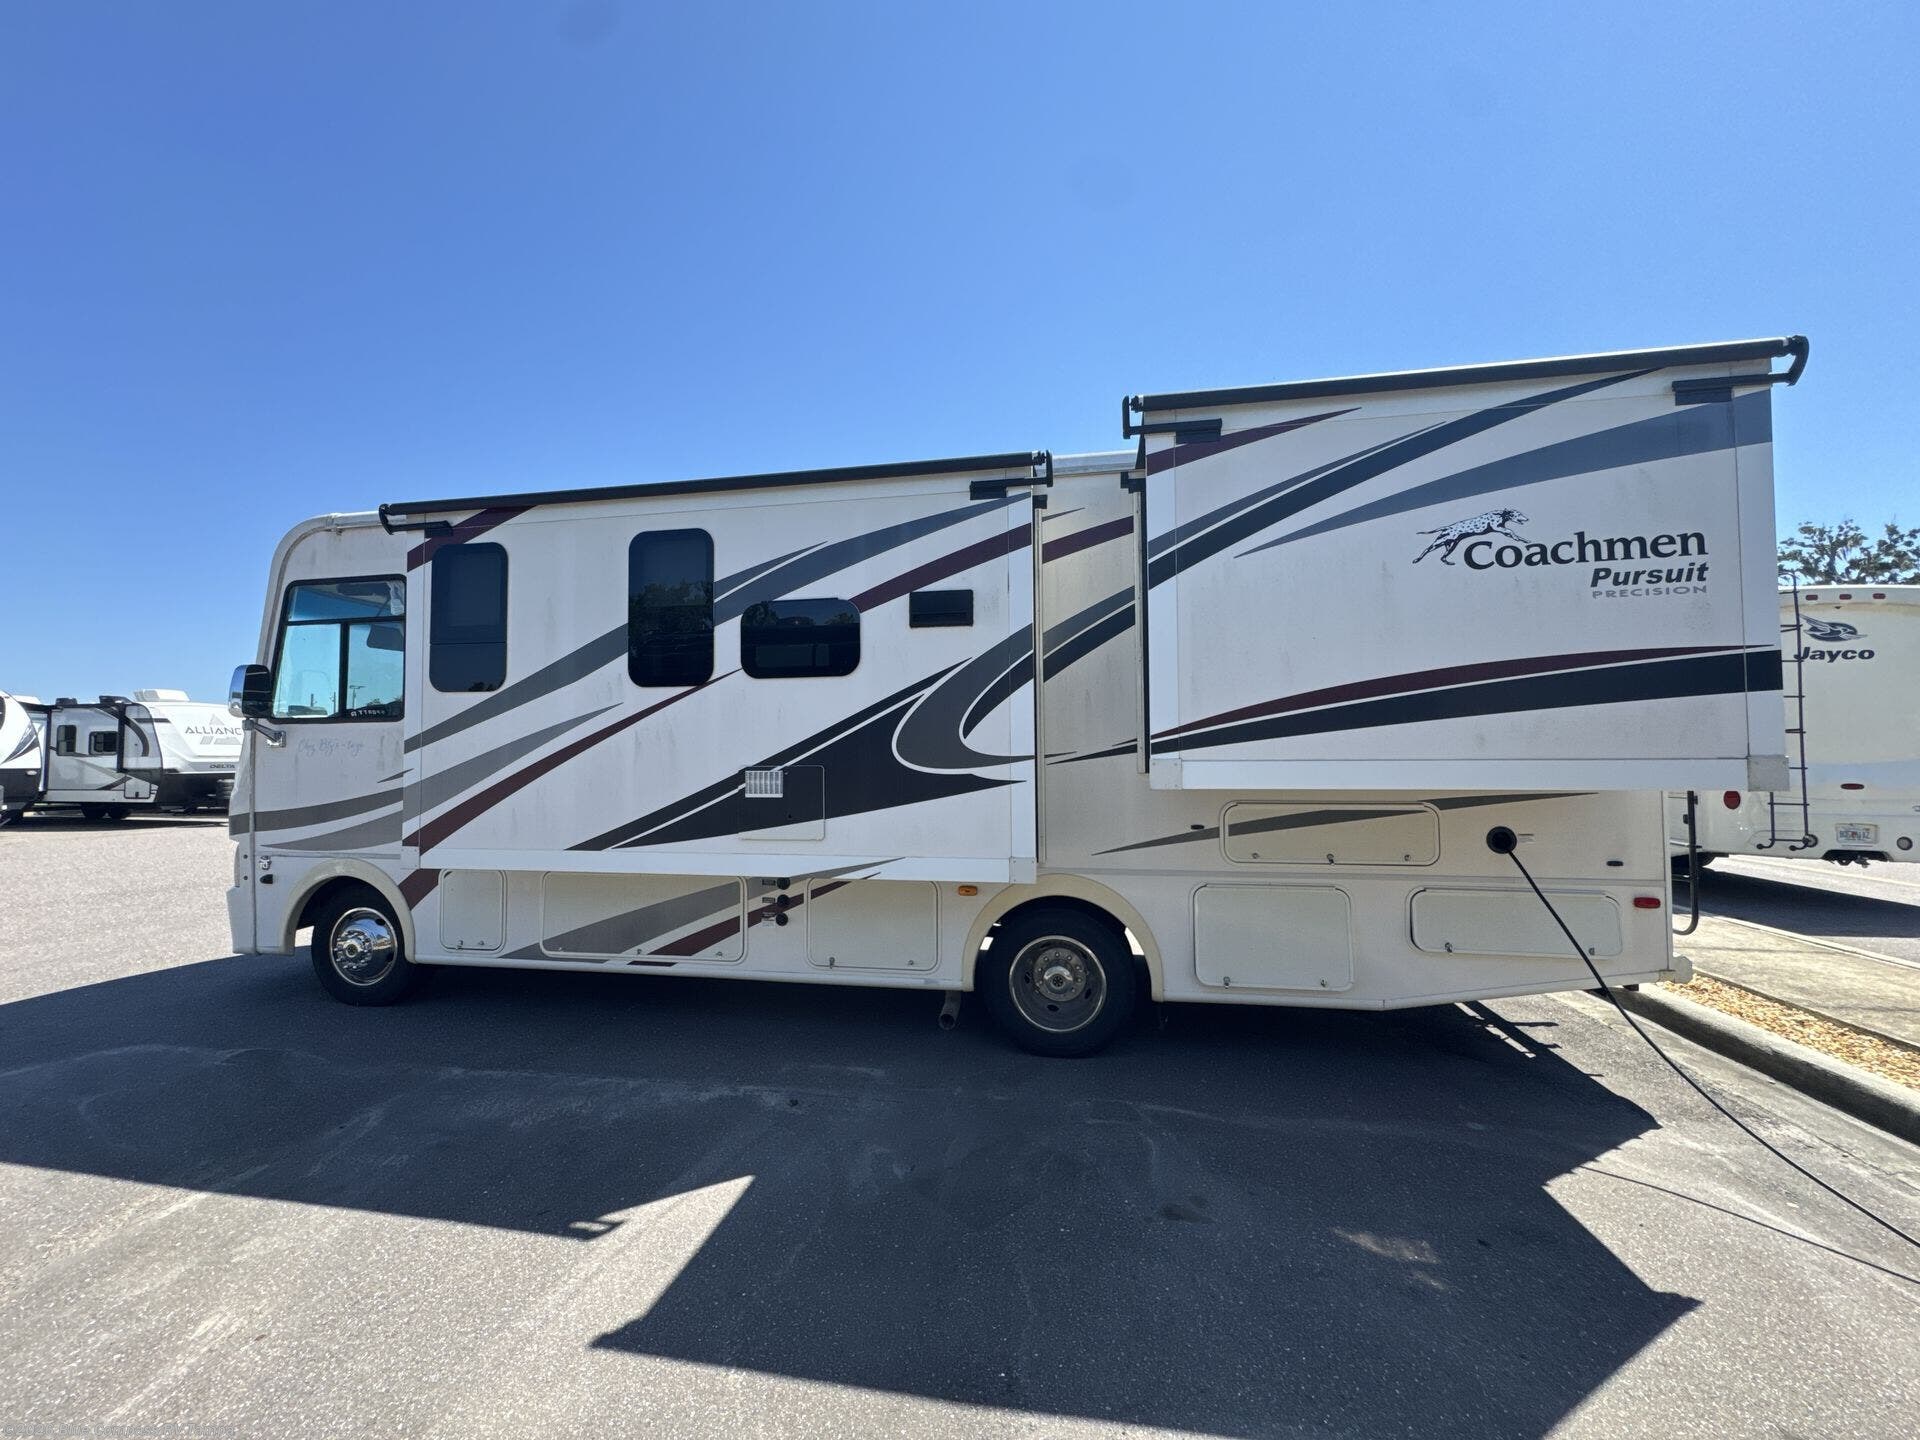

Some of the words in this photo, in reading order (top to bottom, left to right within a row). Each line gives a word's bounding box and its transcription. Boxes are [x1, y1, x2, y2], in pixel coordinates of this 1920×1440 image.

[1463, 531, 1709, 570] Coachmen
[1590, 562, 1709, 588] Pursuit
[1592, 585, 1707, 599] PRECISION
[1793, 646, 1875, 663] Jayco
[185, 726, 242, 735] ALLIANC
